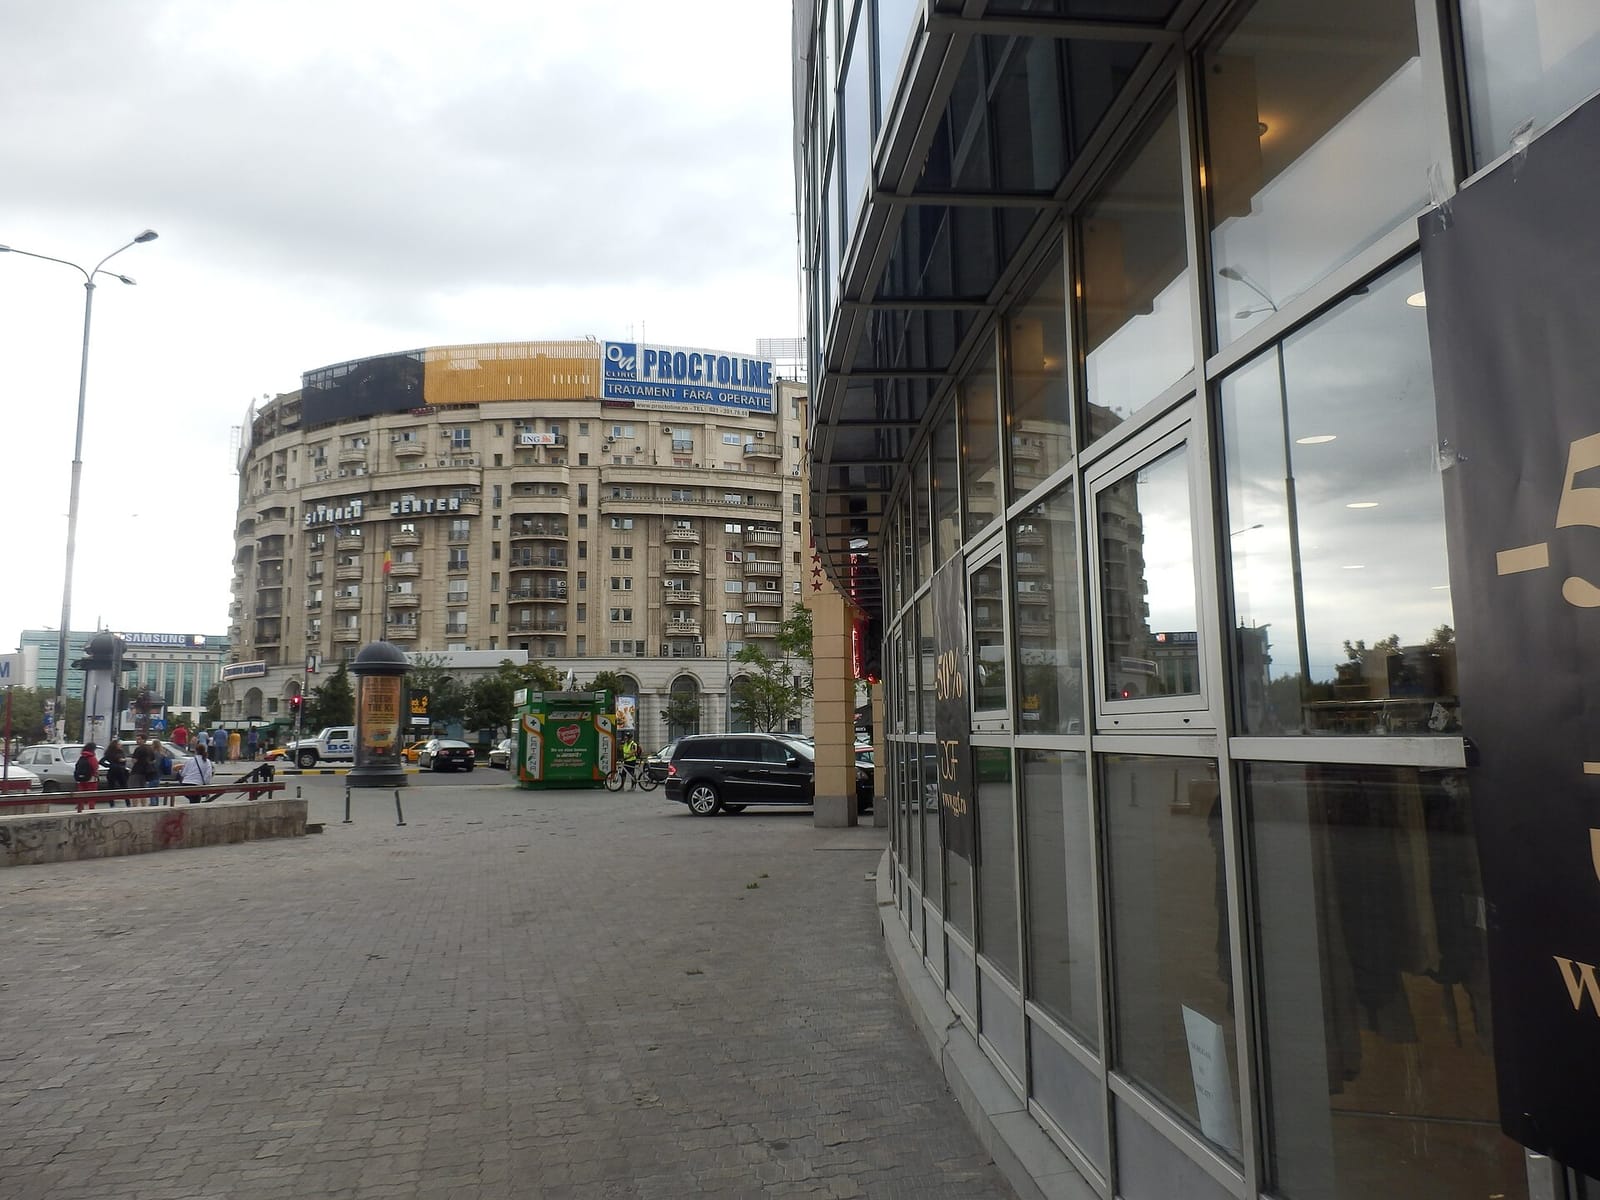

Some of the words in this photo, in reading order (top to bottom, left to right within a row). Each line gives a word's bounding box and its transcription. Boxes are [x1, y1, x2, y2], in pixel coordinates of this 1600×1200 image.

[607, 383, 676, 398] TRATAMENT
[523, 435, 540, 443] ING
[305, 504, 361, 525] SITRACO
[390, 498, 459, 514] CENTER
[125, 633, 186, 643] SAMSUNG
